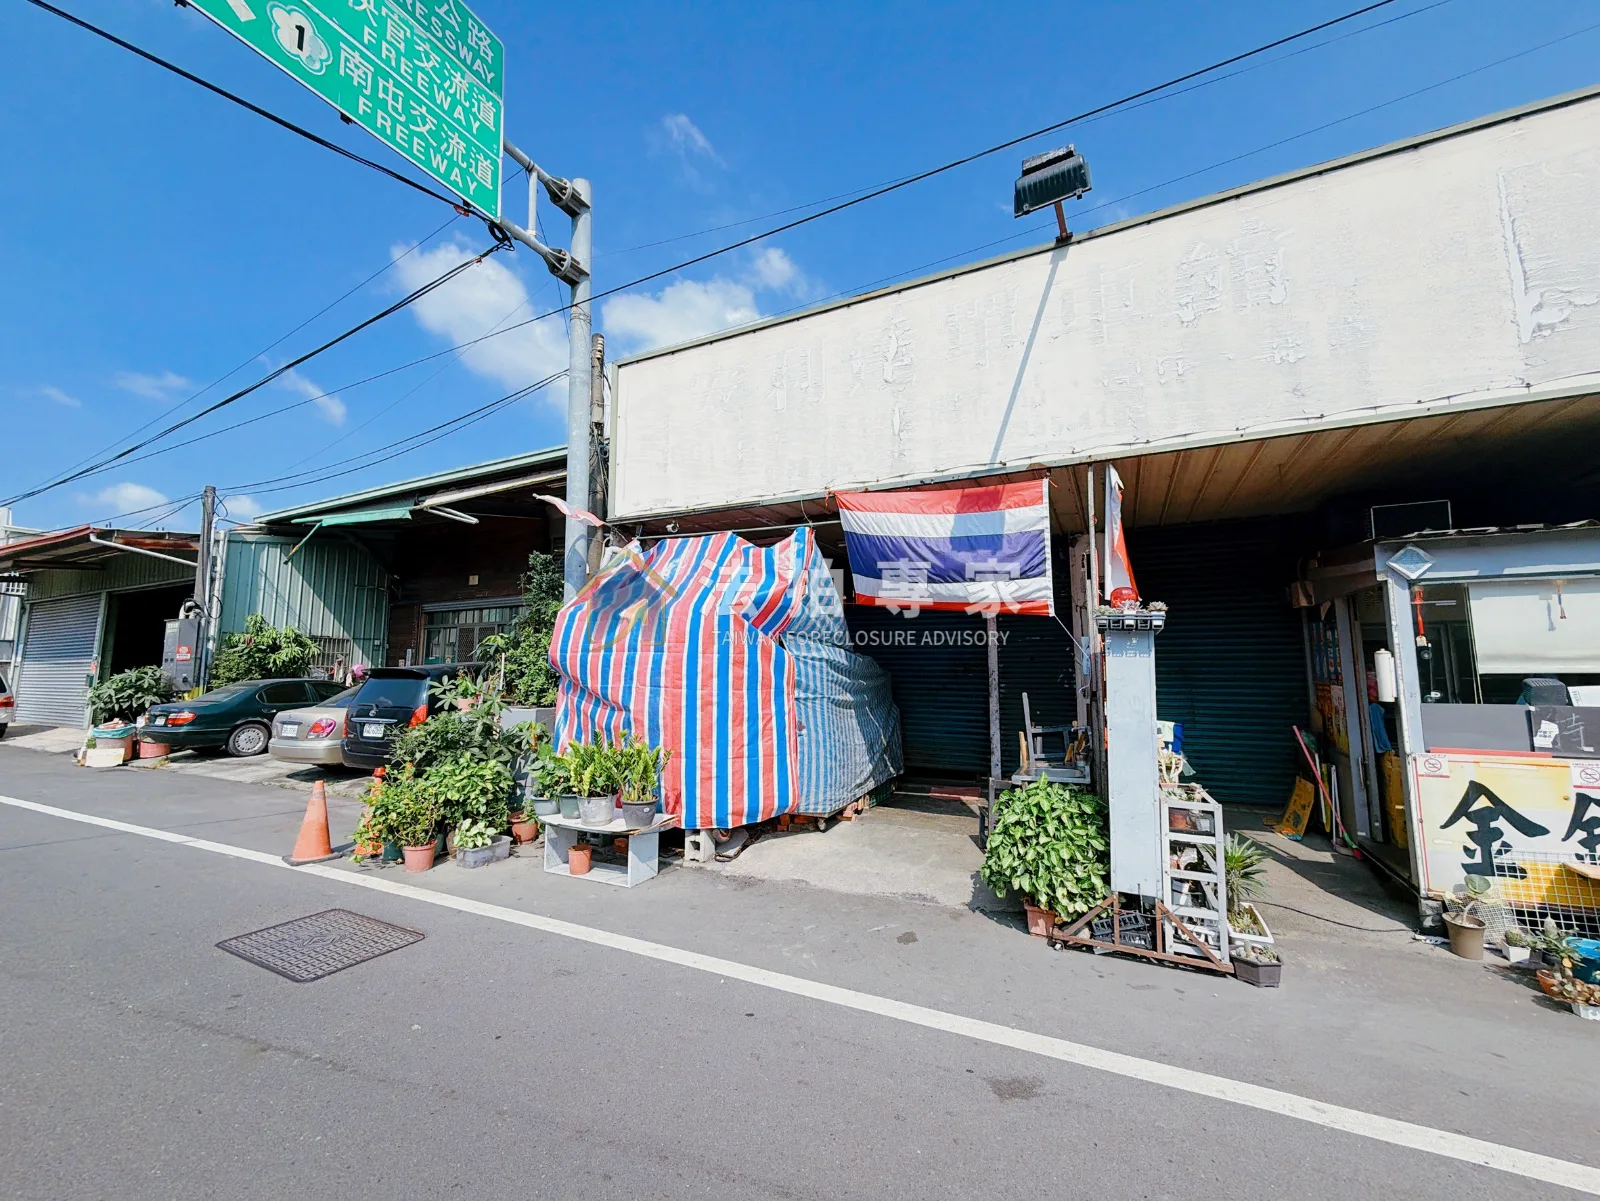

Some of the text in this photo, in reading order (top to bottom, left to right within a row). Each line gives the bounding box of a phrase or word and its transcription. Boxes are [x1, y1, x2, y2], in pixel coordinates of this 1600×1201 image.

[295, 24, 305, 52] 1
[364, 24, 480, 135] FREEWAY
[340, 41, 493, 190] 南屯交流道
[358, 100, 477, 196] FREEWAY
